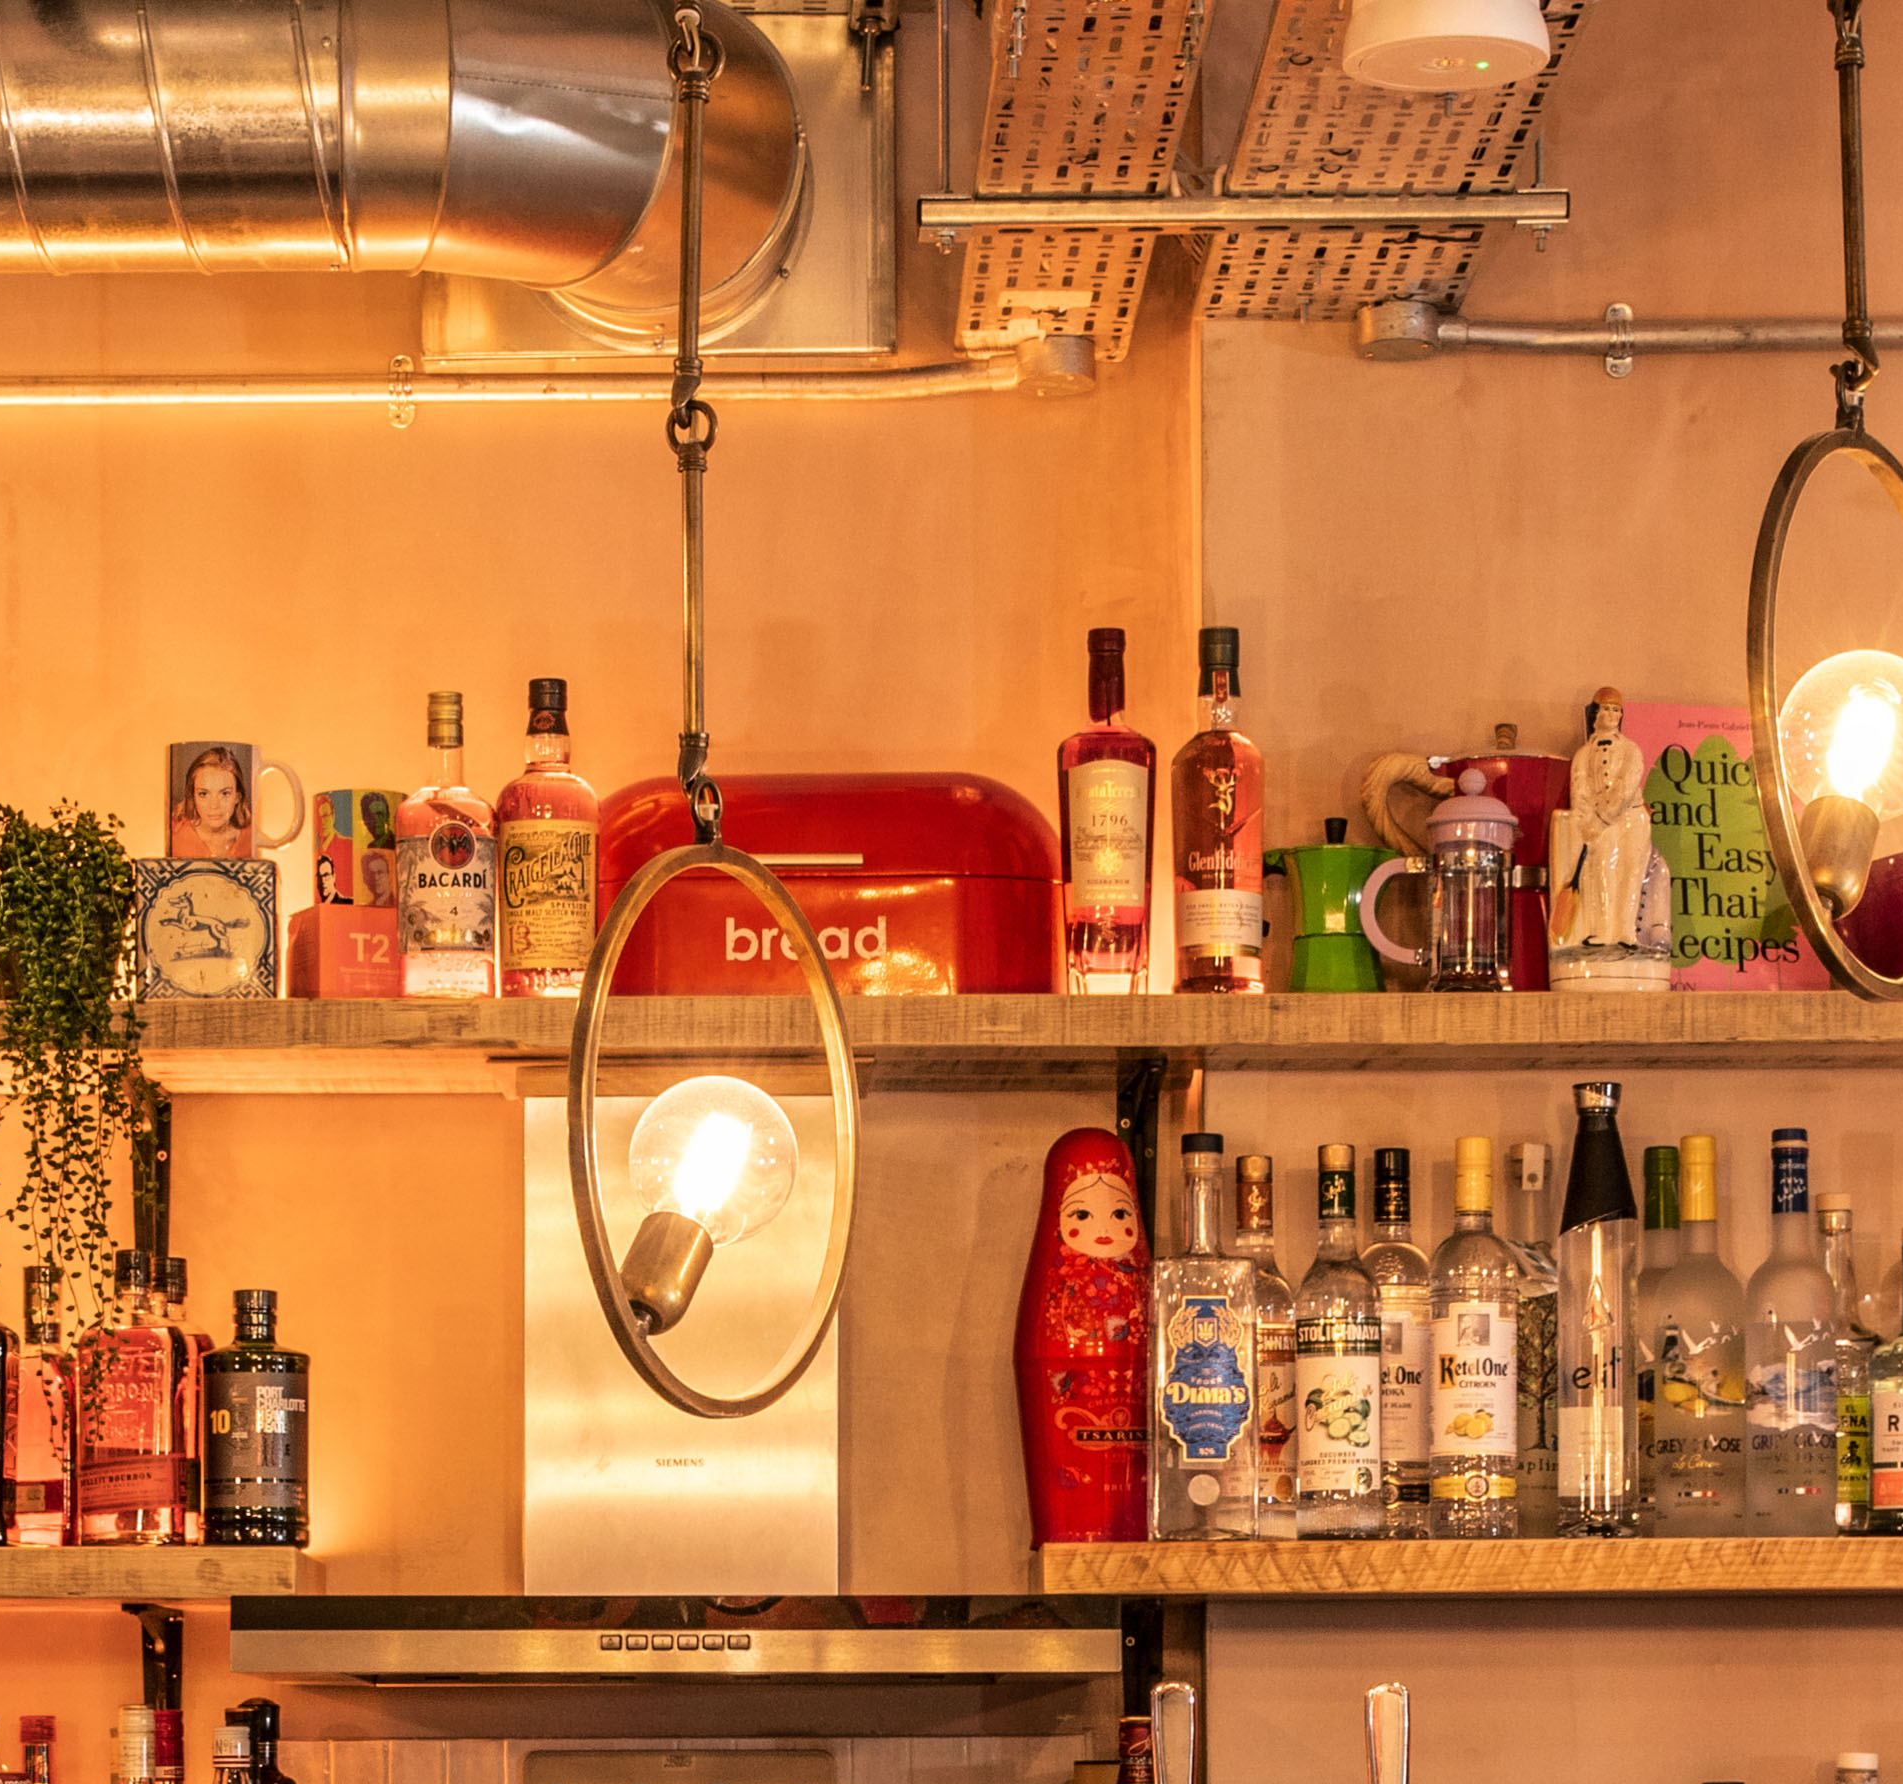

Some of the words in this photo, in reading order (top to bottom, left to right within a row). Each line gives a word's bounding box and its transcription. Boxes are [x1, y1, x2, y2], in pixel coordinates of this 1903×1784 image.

[1660, 742, 1754, 790] Quic
[1091, 814, 1129, 827] 1796
[1649, 791, 1719, 829] and
[1696, 833, 1778, 876] Easy
[417, 869, 488, 889] BACARDÍ
[1671, 878, 1763, 920] Thai
[449, 906, 459, 917] 4
[349, 933, 391, 964] T2
[508, 924, 531, 954] 13
[1671, 930, 1801, 975] ecipes
[1440, 1353, 1480, 1386] Ketel
[1481, 1357, 1509, 1380] One
[256, 1386, 284, 1399] PORT
[1165, 1381, 1246, 1404] Dima's
[1458, 1380, 1497, 1390] CITROEN
[210, 1409, 230, 1434] 10
[1080, 1429, 1146, 1441] TSARIN
[1656, 1439, 1684, 1454] GREY
[107, 1471, 152, 1484] BOURBON
